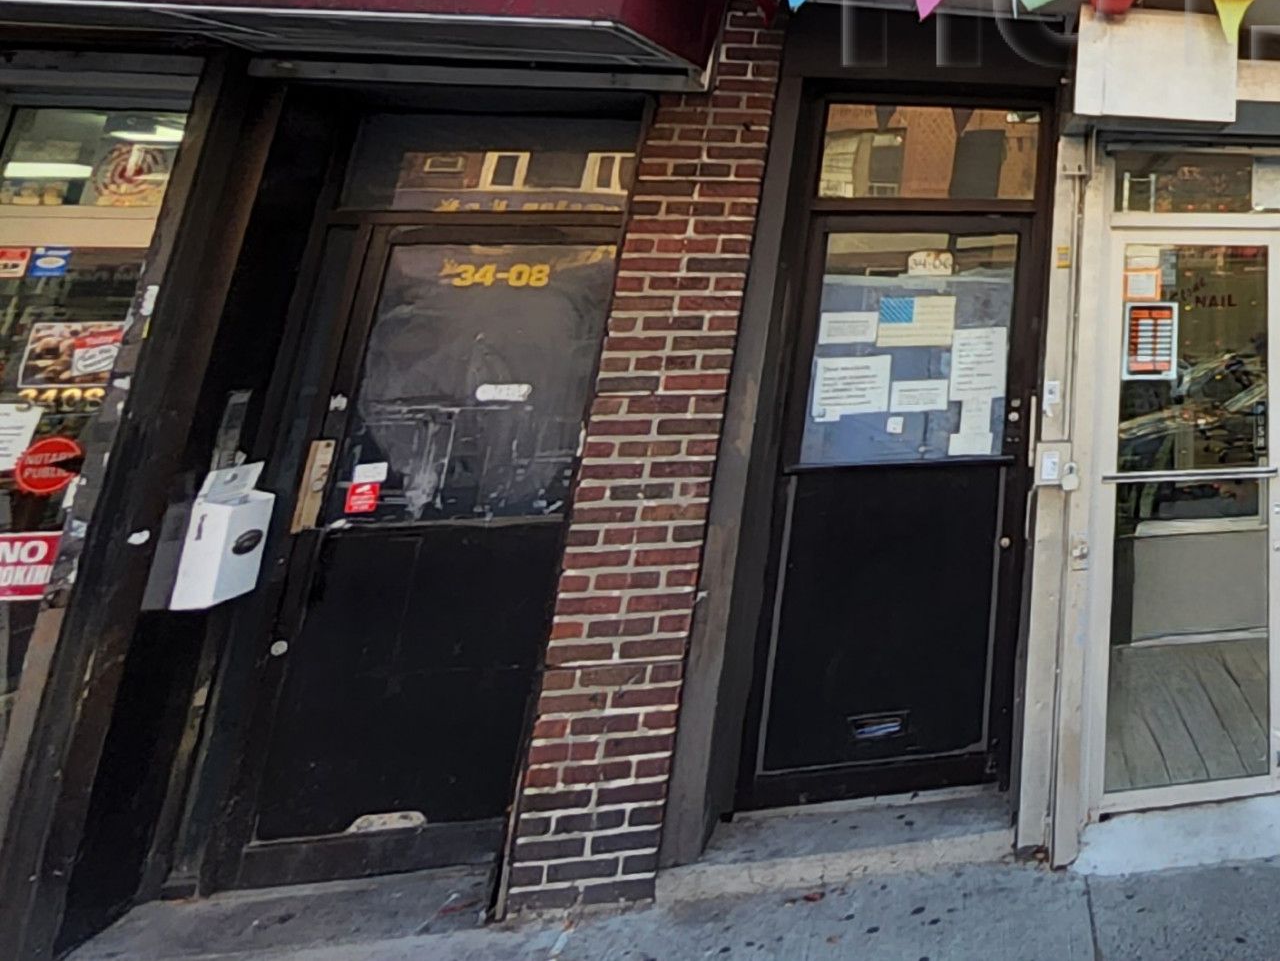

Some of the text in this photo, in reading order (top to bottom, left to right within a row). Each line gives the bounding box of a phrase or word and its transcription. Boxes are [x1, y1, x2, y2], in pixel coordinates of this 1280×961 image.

[451, 262, 550, 287] 34-08
[1195, 295, 1238, 308] NAIL
[25, 452, 74, 465] NOTA
[0, 540, 48, 564] NO
